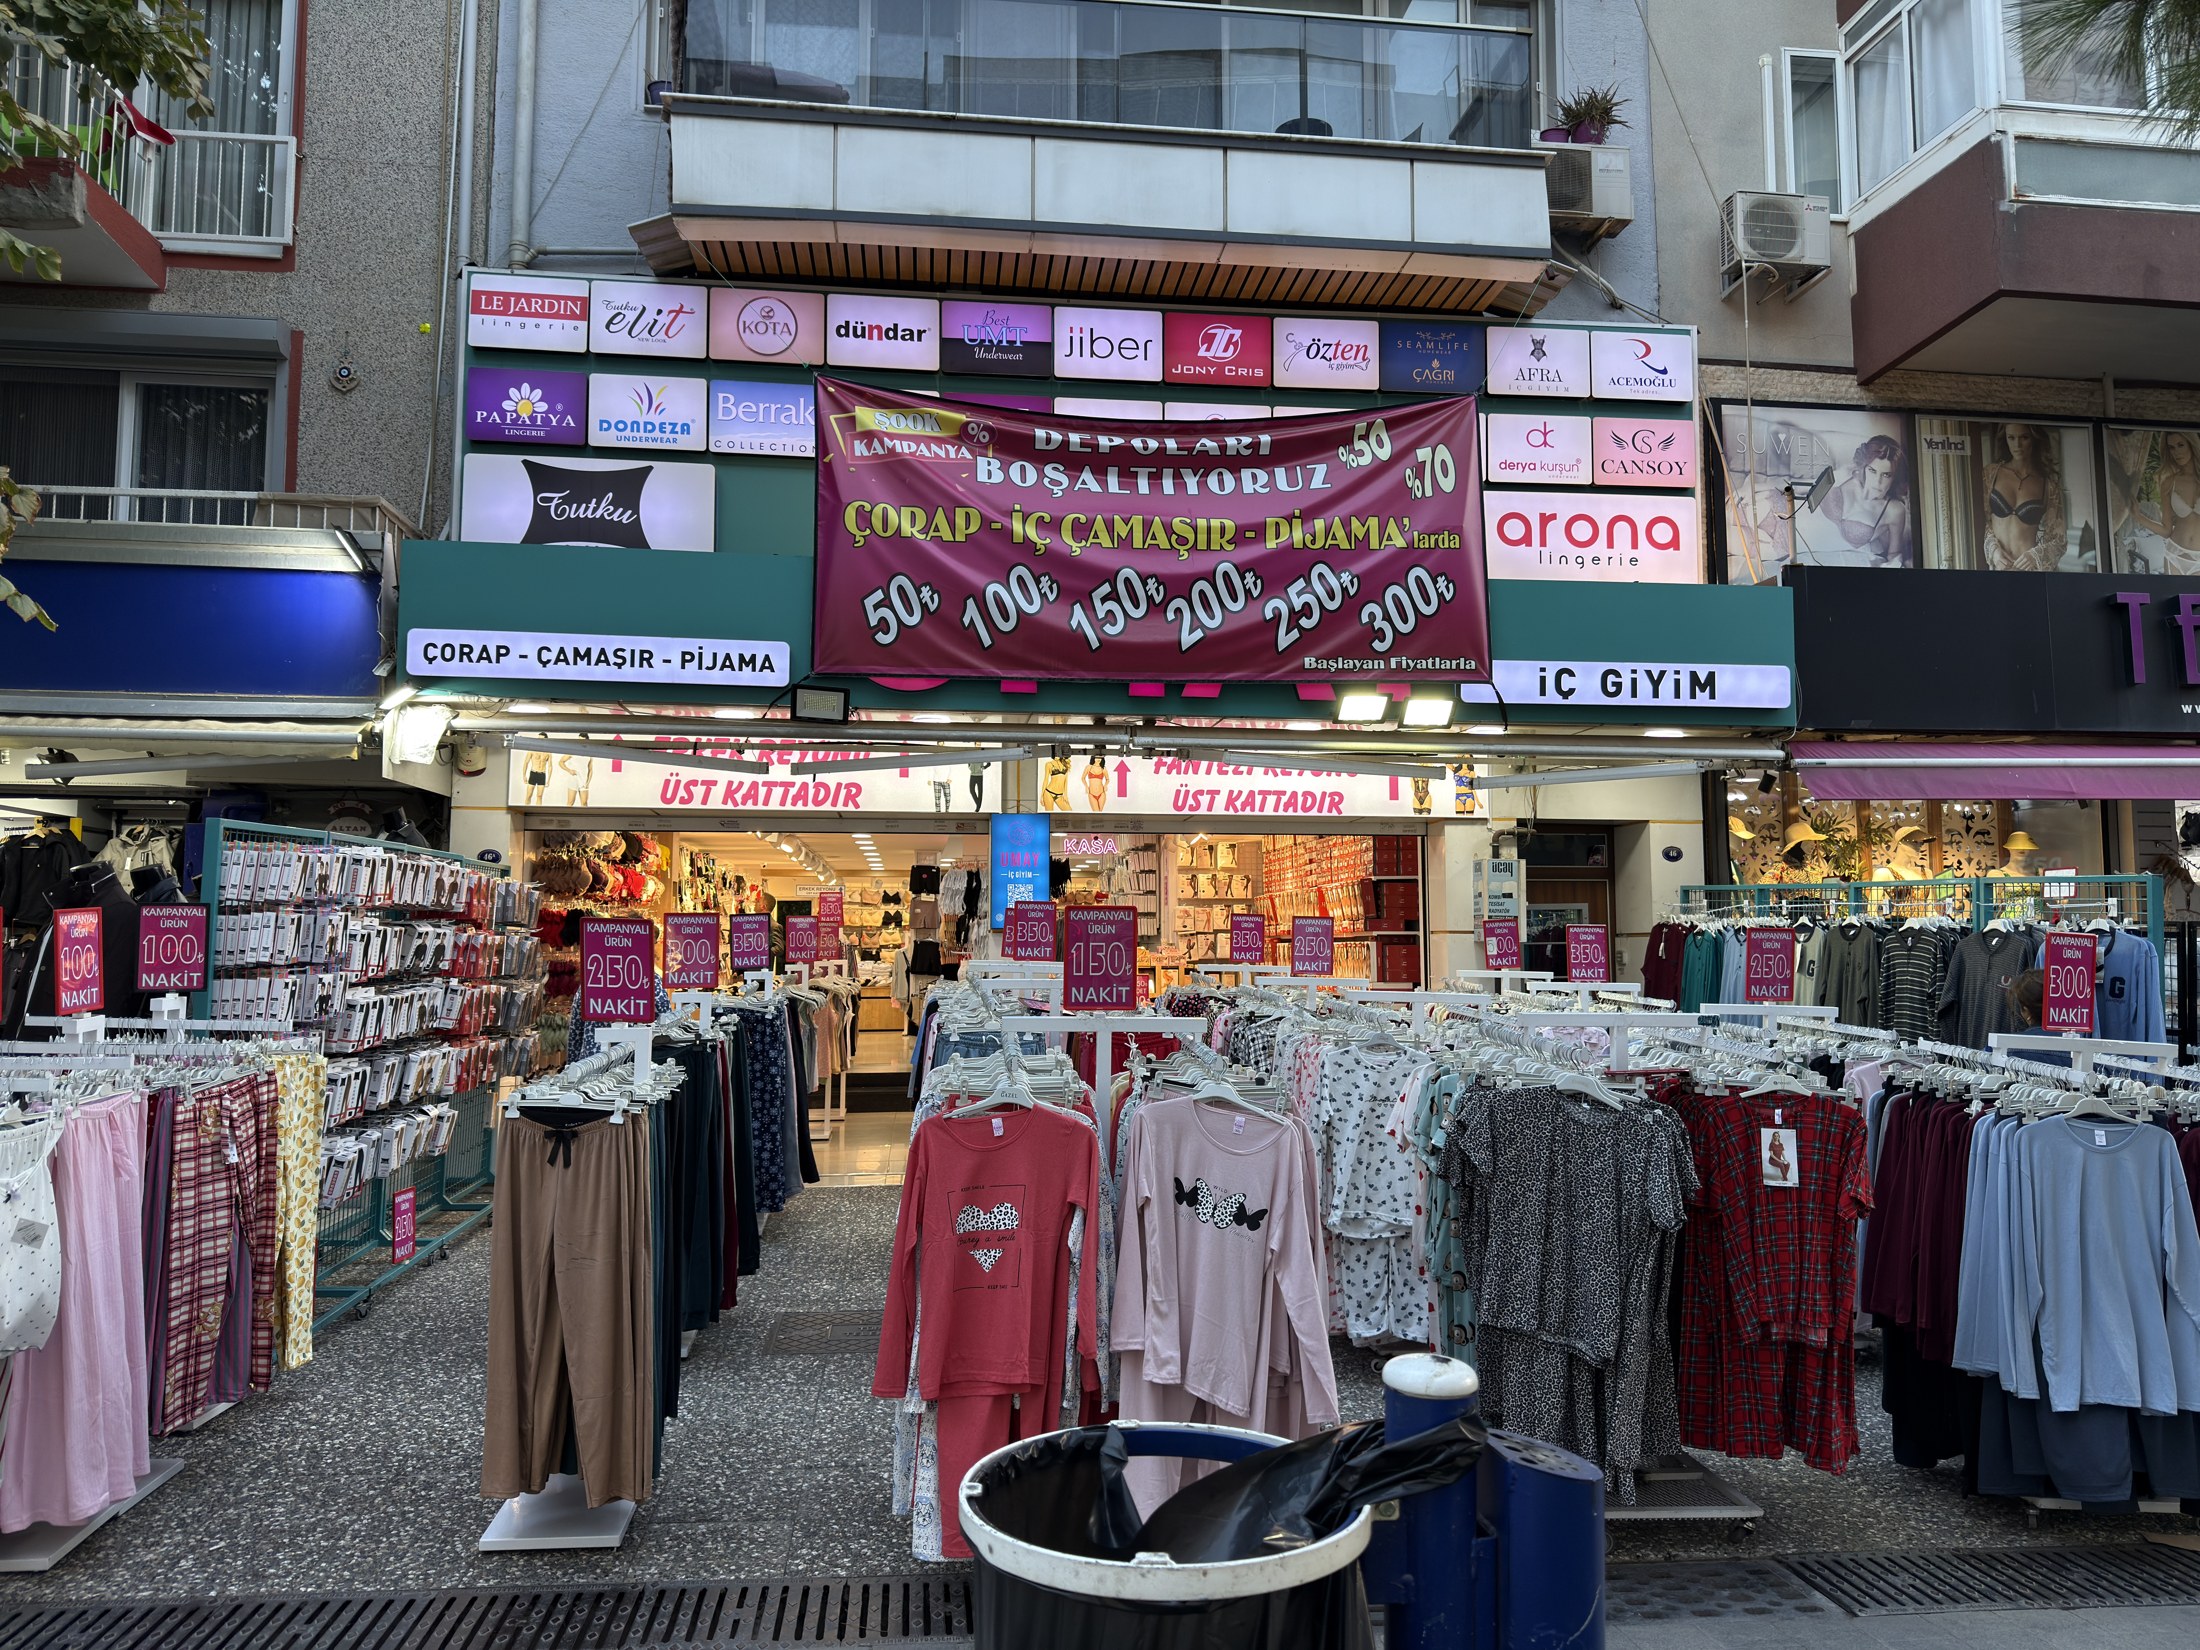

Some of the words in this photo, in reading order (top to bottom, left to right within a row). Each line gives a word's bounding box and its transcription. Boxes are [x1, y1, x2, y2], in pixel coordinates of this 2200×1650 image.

[480, 295, 504, 312] LE
[506, 297, 582, 316] JARDIN
[481, 318, 580, 332] lingerie
[605, 302, 695, 339] elit
[982, 309, 1011, 326] Best
[742, 319, 793, 336] KOTA
[835, 320, 927, 342] dündar
[962, 324, 1028, 347] UMT
[1064, 326, 1153, 361] jiber
[1306, 338, 1370, 362] özten
[1397, 340, 1469, 351] SEAMLIFE
[974, 347, 1024, 361] Underwear
[1336, 363, 1355, 372] giyim
[1514, 367, 1563, 382] AFRA
[1608, 375, 1677, 388] ACEMOĞLU
[717, 392, 815, 426] Berrak
[475, 410, 576, 427] PAPATYA
[873, 412, 942, 433] ŞOOK
[505, 428, 546, 437] LINGERIE
[598, 419, 691, 435] DONDEZA
[616, 435, 678, 444] UNDERWEAR
[1034, 428, 1272, 455] DEPOLARI
[1338, 418, 1392, 470] %50
[1736, 432, 1830, 457] SUWEN
[853, 438, 973, 460] KAMPANYA
[1404, 443, 1456, 500] %70
[1499, 459, 1537, 472] derya
[1540, 460, 1580, 475] kurşun
[1601, 458, 1688, 476] CANSOY
[975, 455, 1332, 497] BOŞALTIYORUZ
[536, 489, 638, 524] Tutku
[843, 500, 982, 547] ÇORAP
[1011, 503, 1051, 555] İÇ
[1060, 513, 1237, 560] ÇAMAŞIR
[1496, 511, 1681, 551] arona
[1539, 550, 1639, 569] lingerie
[423, 643, 510, 664] ÇORAP
[536, 645, 654, 669] ÇAMAŞIR
[680, 645, 775, 673] PİJAMA
[1303, 657, 1385, 672] Başlayan
[1390, 657, 1477, 672] Fiyatlarla
[660, 772, 718, 805] ÜST
[721, 780, 863, 809] KATTADIR
[1172, 783, 1221, 813] ÜST
[1224, 790, 1345, 815] KATTADIR
[1064, 837, 1118, 855] KASA
[1668, 849, 1677, 857] 46
[1001, 852, 1041, 867] UMAY
[59, 914, 98, 925] KAMPANYALI
[142, 907, 206, 917] KAMPANYALI
[732, 916, 768, 924] KAMPANYALI
[1070, 910, 1133, 921] KAMPANYALI
[160, 917, 188, 928] ÜRÜN
[586, 922, 650, 935] KAMPANYALI
[668, 916, 717, 925] KAMPANYALI
[742, 922, 759, 930] ÜRÜN
[1088, 923, 1116, 934] ÜRÜN
[681, 925, 703, 934] ÜRÜN
[604, 936, 632, 948] ÜRÜN
[1762, 940, 1780, 949] ÜRÜN
[2051, 936, 2093, 947] KAMPANYALI
[789, 950, 815, 959] NAKİT
[1017, 946, 1052, 957] NAKİT
[1233, 950, 1261, 960] NAKİT
[2063, 949, 2081, 959] ÜRÜN
[734, 955, 767, 966] NAKİT
[1295, 960, 1329, 971] NAKİT
[1489, 956, 1518, 966] NAKİT
[141, 970, 202, 988] NAKİT
[668, 969, 714, 985] NAKİT
[1572, 967, 1605, 978] NAKİT
[1071, 984, 1130, 1003] NAKİT
[1751, 984, 1789, 997] NAKİT
[2109, 976, 2126, 998] G
[62, 986, 99, 1008] NAKİT
[589, 996, 648, 1016] NAKİT
[2050, 1006, 2089, 1023] NAKİT
[1213, 1185, 1228, 1194] WILD
[997, 1231, 1016, 1242] smile
[395, 1242, 413, 1259] NAKİT
